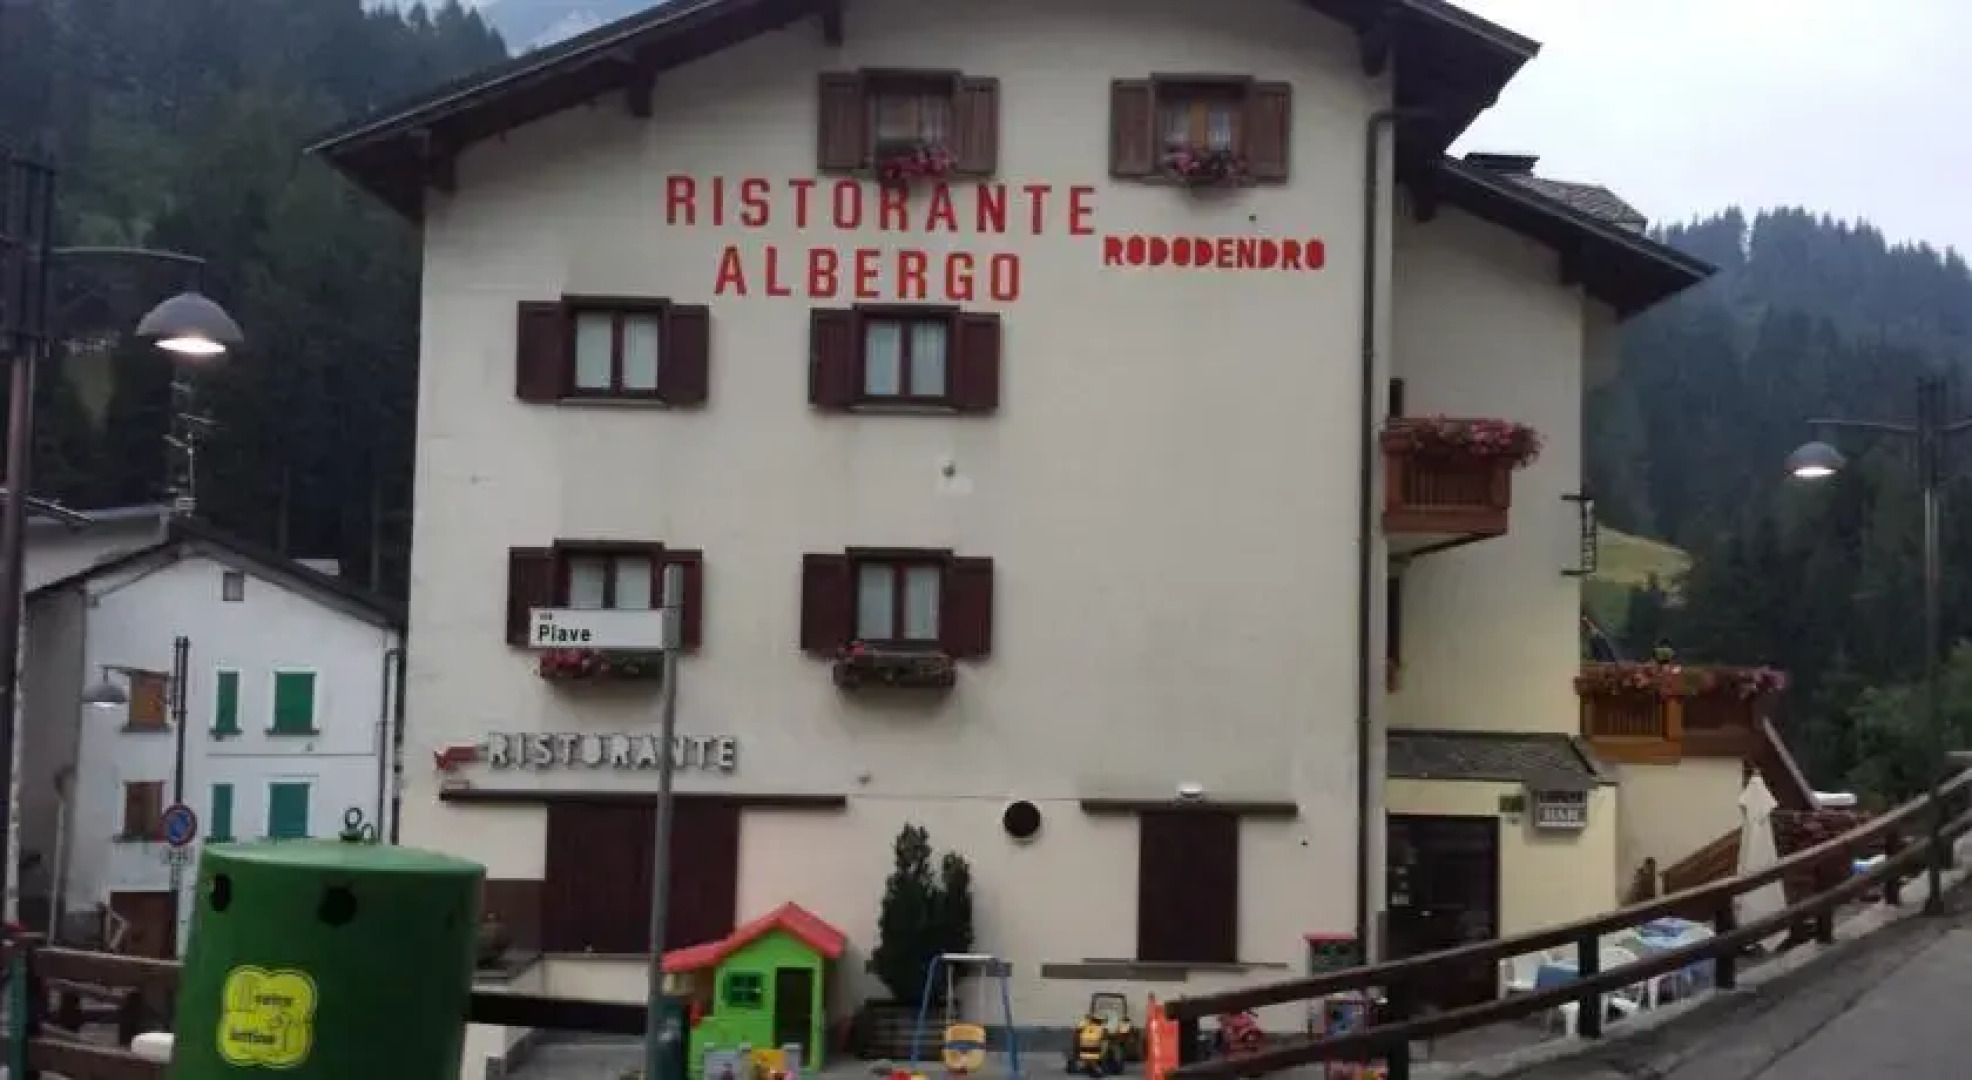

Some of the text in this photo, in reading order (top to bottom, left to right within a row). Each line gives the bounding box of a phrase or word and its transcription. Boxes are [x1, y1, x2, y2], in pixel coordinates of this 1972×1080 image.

[667, 176, 1095, 235] RISTORANTE
[715, 246, 1021, 302] ALBERGO
[1102, 236, 1326, 270] RODODENDRO
[488, 734, 736, 769] RISTORANTE
